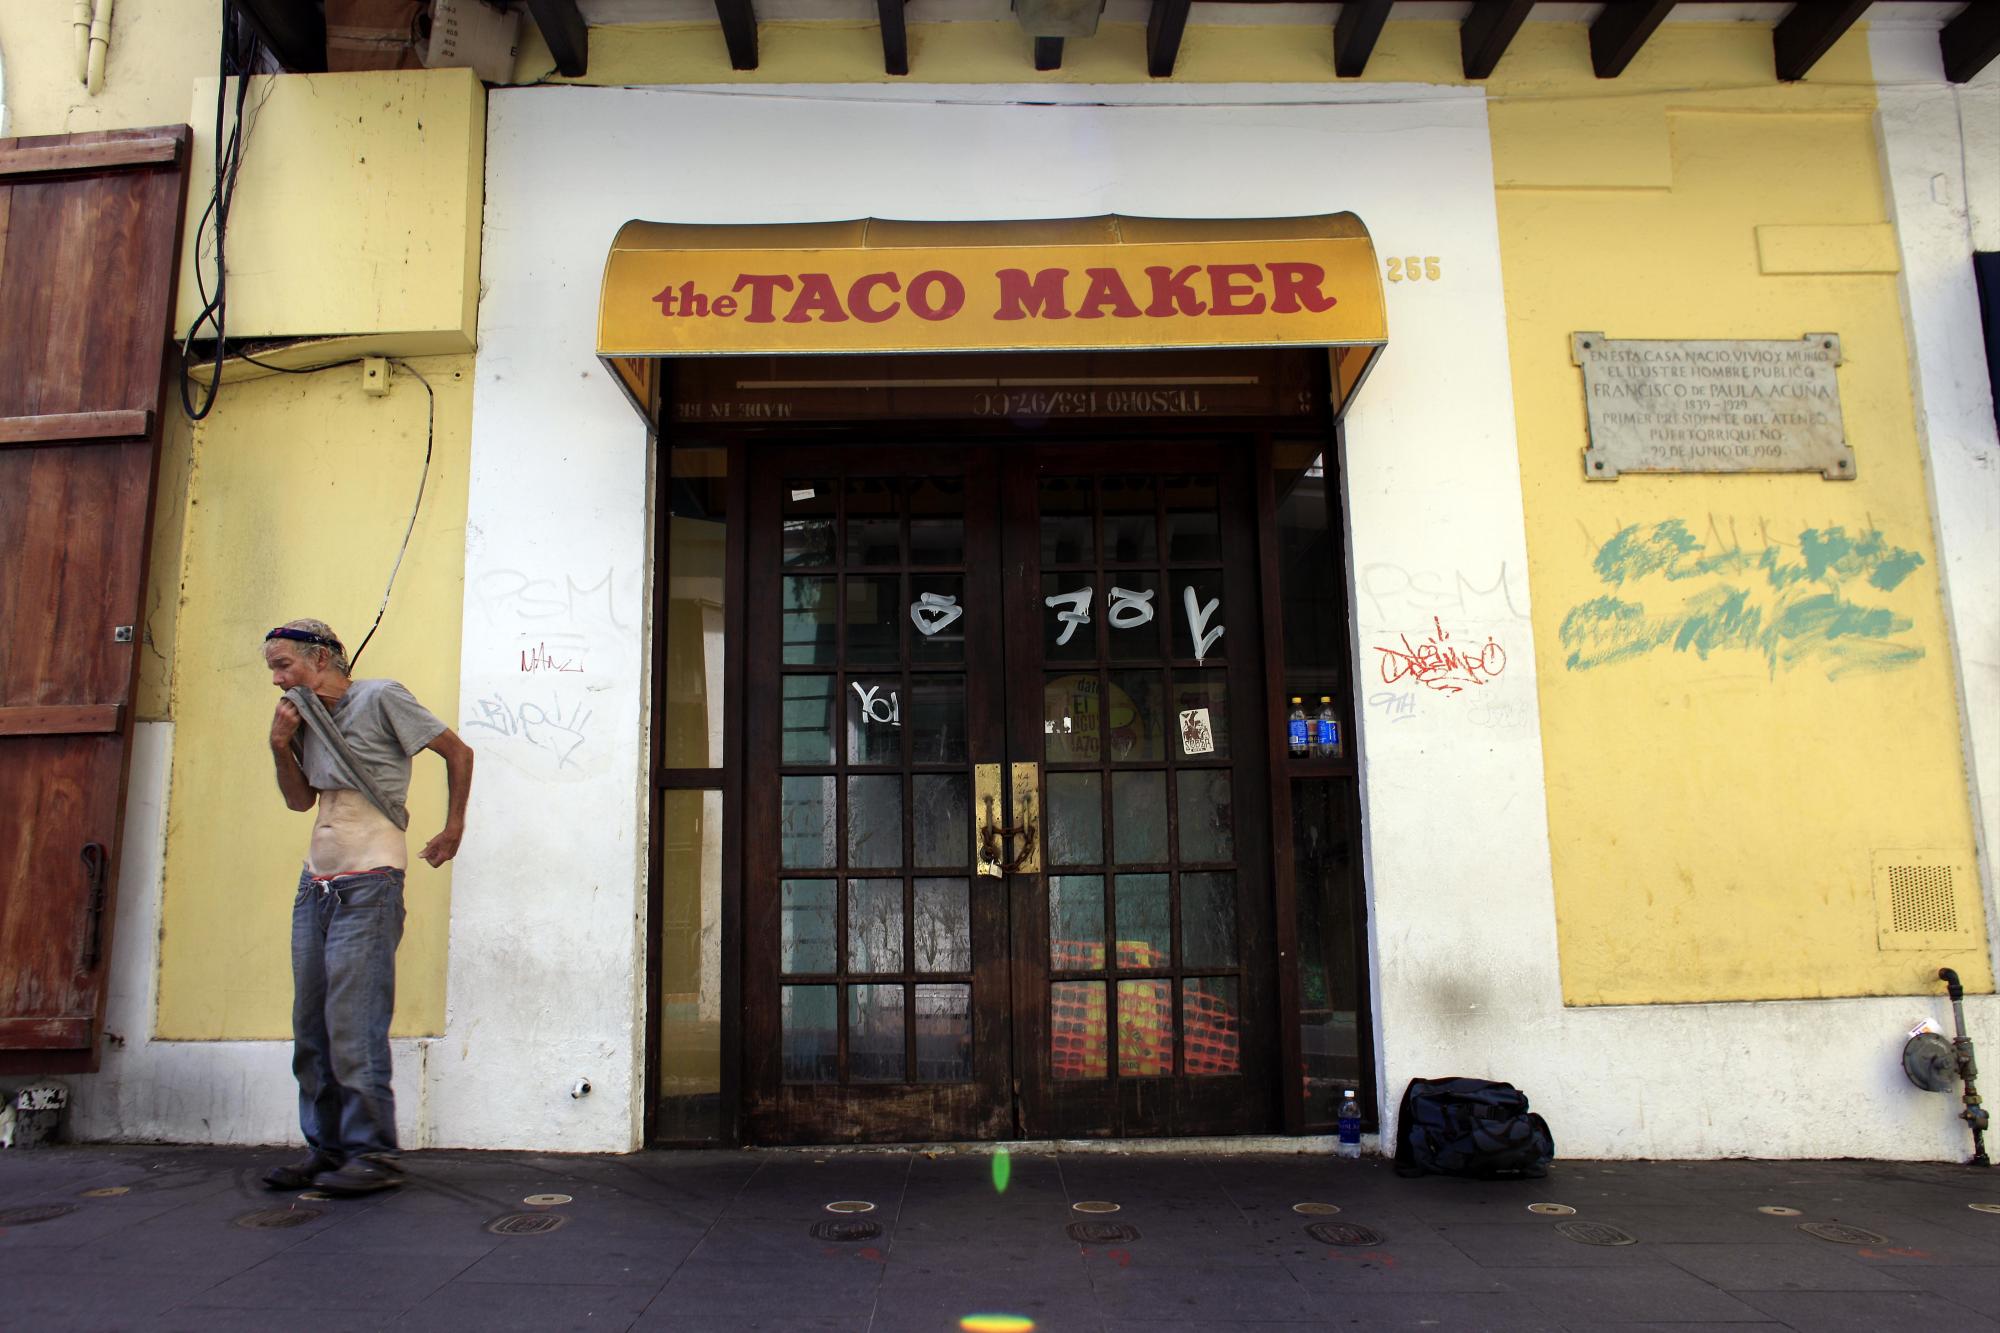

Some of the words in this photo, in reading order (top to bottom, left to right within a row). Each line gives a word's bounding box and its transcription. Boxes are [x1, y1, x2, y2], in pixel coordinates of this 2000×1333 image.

[1386, 256, 1441, 281] 255
[652, 281, 738, 317] the
[732, 270, 966, 323] TACO
[993, 262, 1337, 320] MAKER
[1590, 350, 1608, 361] EN
[1610, 350, 1641, 361] ESTA
[1643, 350, 1681, 361] CASA
[1627, 365, 1687, 378] ILUSTRE
[1691, 366, 1751, 379] HOMBRE
[1594, 383, 1688, 398] FRANCISCO
[1710, 383, 1763, 398] PAULA
[736, 402, 793, 417] MADE
[1106, 390, 1208, 415] TESORO
[1603, 412, 1652, 424] PRIMER
[1656, 412, 1739, 425] PRESIDENTE
[1744, 414, 1769, 425] DEL
[1771, 413, 1828, 425] ATENEO
[1670, 446, 1686, 457] DE
[1690, 446, 1732, 459] JUNIO
[1735, 446, 1751, 457] DE
